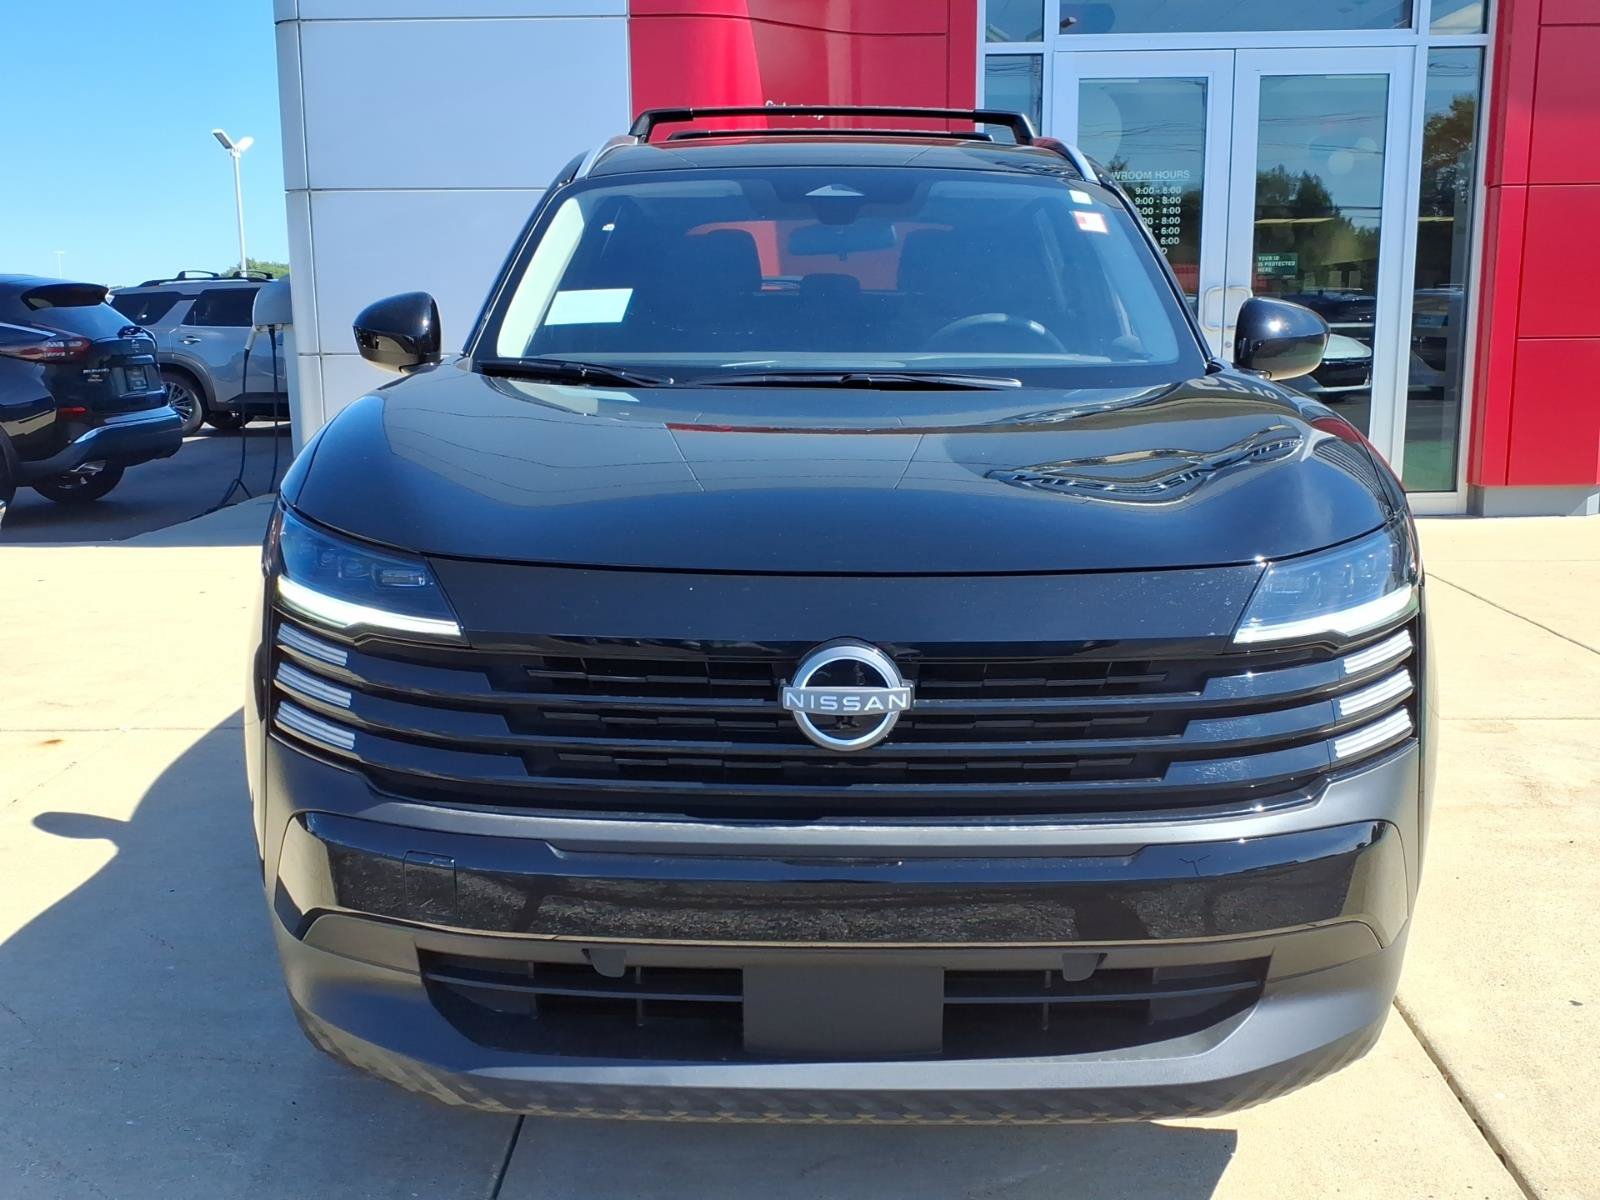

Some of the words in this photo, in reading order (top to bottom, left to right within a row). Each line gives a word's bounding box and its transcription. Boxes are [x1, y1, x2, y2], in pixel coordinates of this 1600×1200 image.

[1155, 169, 1190, 179] HOURS
[1135, 197, 1154, 205] 9:00
[1160, 226, 1180, 234] 6:00
[1160, 237, 1180, 245] 6:00
[785, 692, 907, 711] NISSAN
